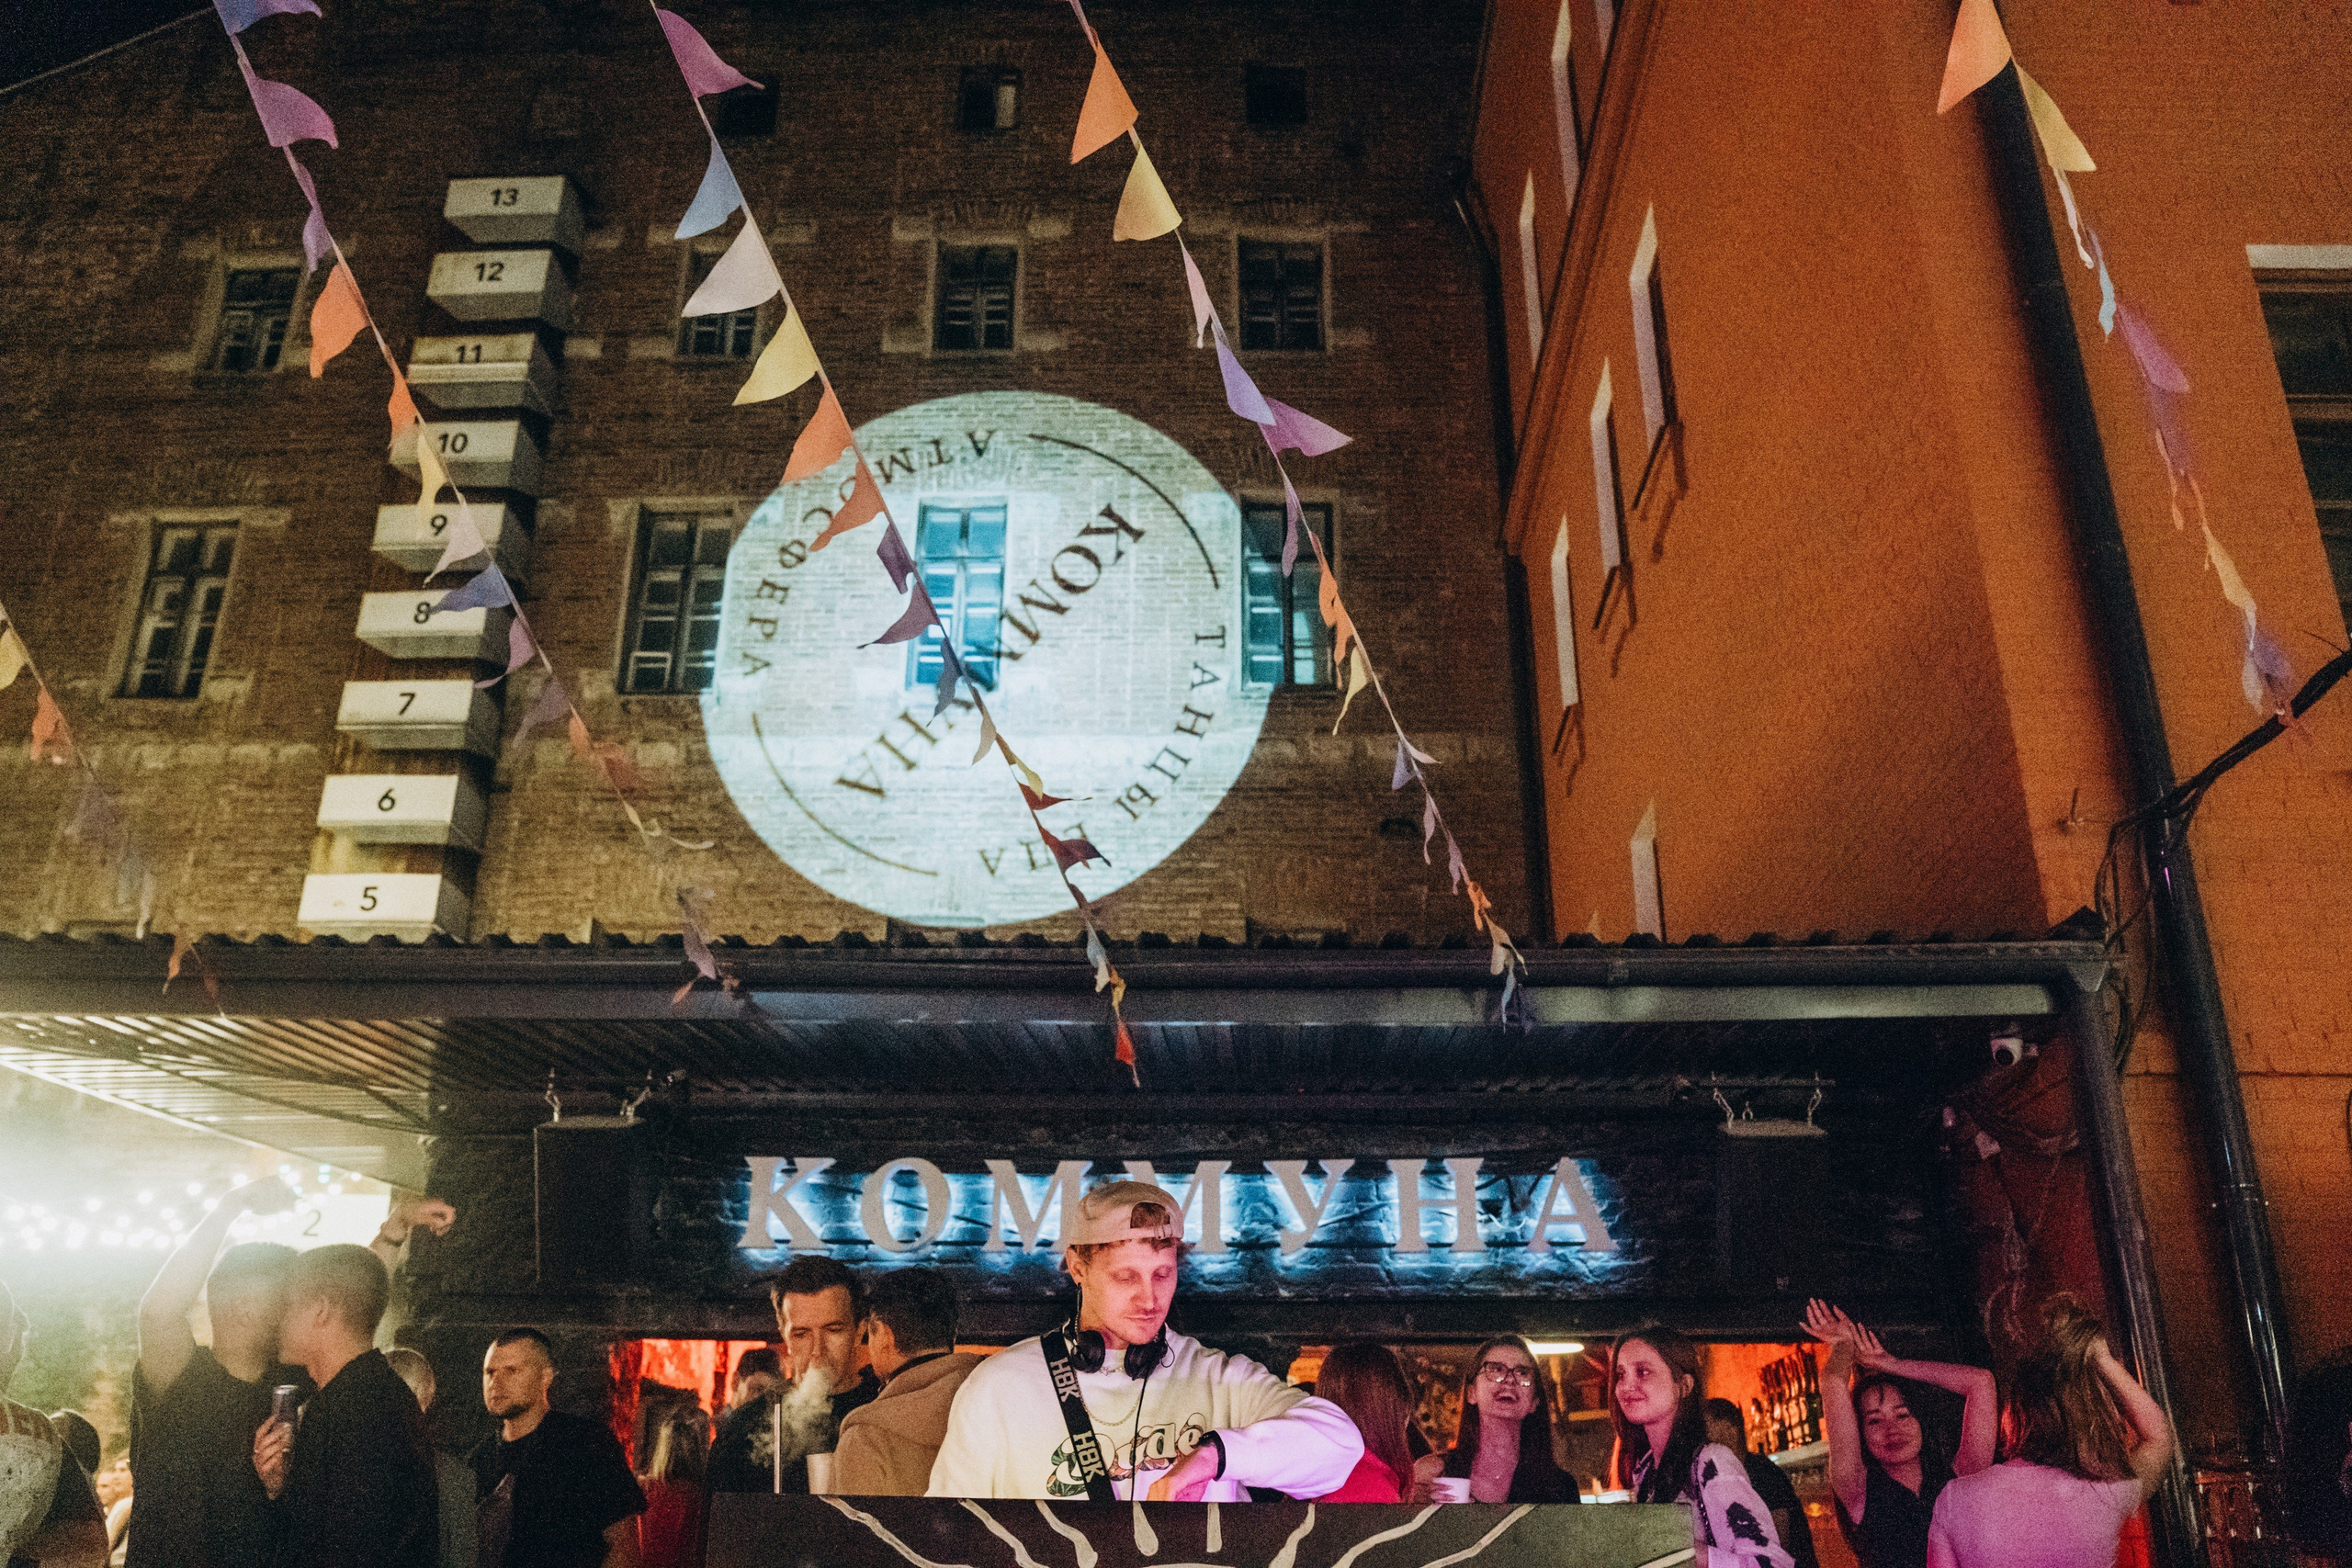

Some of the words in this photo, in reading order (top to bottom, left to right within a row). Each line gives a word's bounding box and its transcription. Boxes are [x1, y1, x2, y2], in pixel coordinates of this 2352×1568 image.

[490, 188, 519, 206] 13
[474, 262, 505, 282] 12
[456, 344, 482, 364] 11
[438, 433, 469, 454] 10
[430, 514, 447, 536] 9
[413, 602, 432, 624] 8
[398, 692, 416, 716] 7
[1114, 625, 1227, 821] ТАНЦЫ
[378, 788, 396, 812] 6
[359, 886, 379, 911] 5
[737, 1155, 1622, 1253] КОММУНА
[302, 1209, 322, 1237] 2
